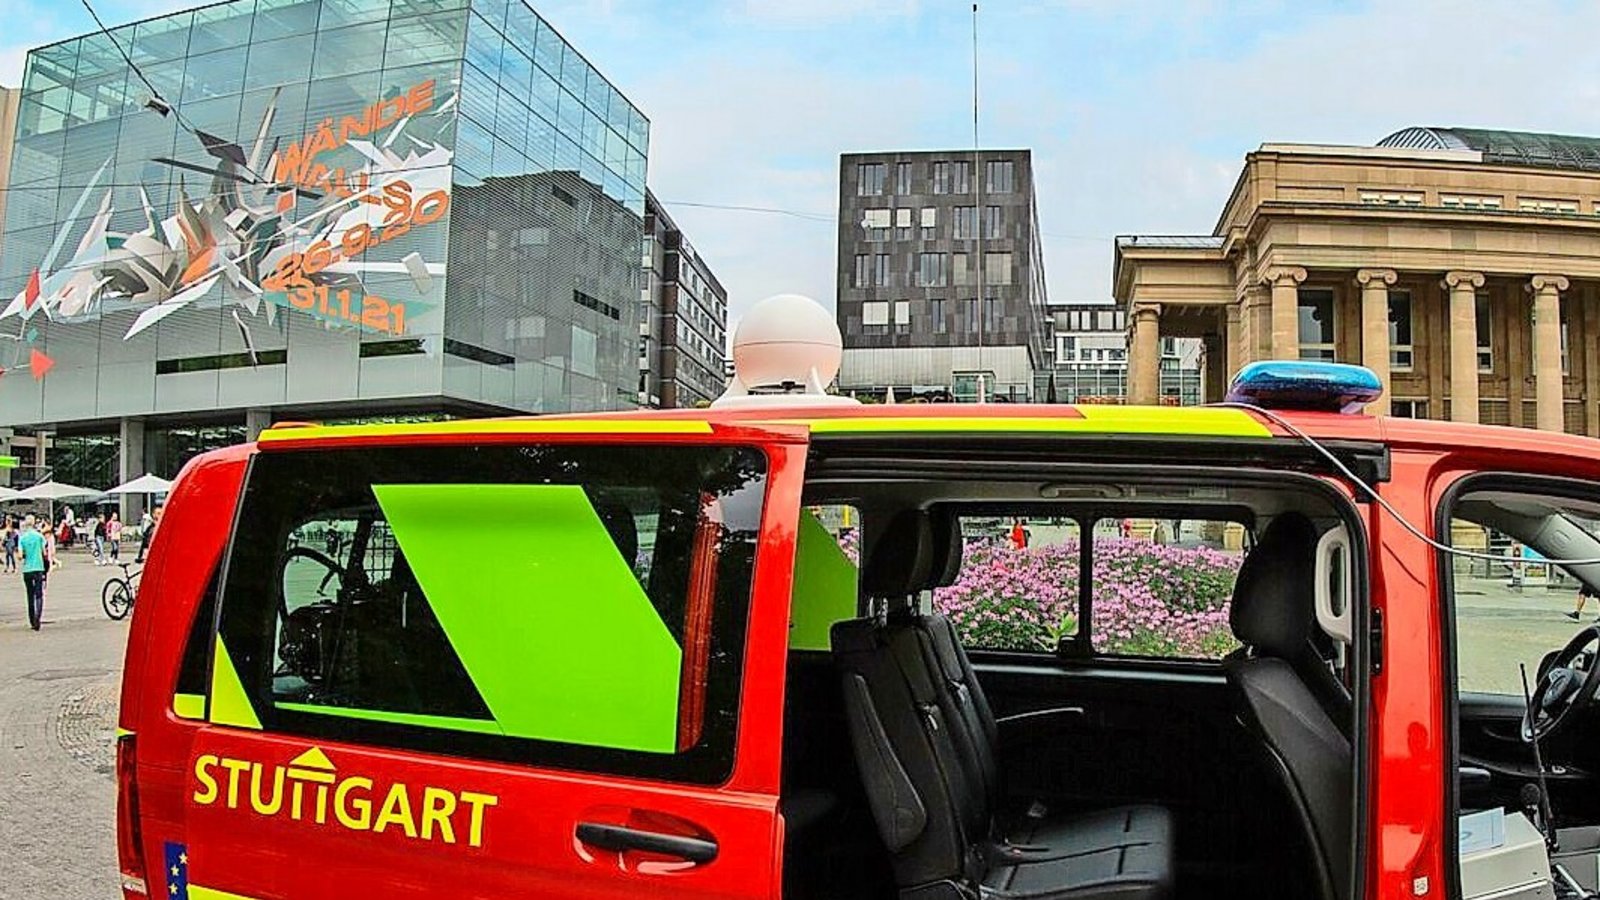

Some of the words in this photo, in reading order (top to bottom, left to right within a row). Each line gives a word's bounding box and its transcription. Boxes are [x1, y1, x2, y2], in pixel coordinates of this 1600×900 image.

[276, 80, 435, 168] WÄNDE
[276, 154, 413, 211] WALLS
[261, 190, 449, 291] 26.9.20
[193, 746, 498, 847] STUTTGART
